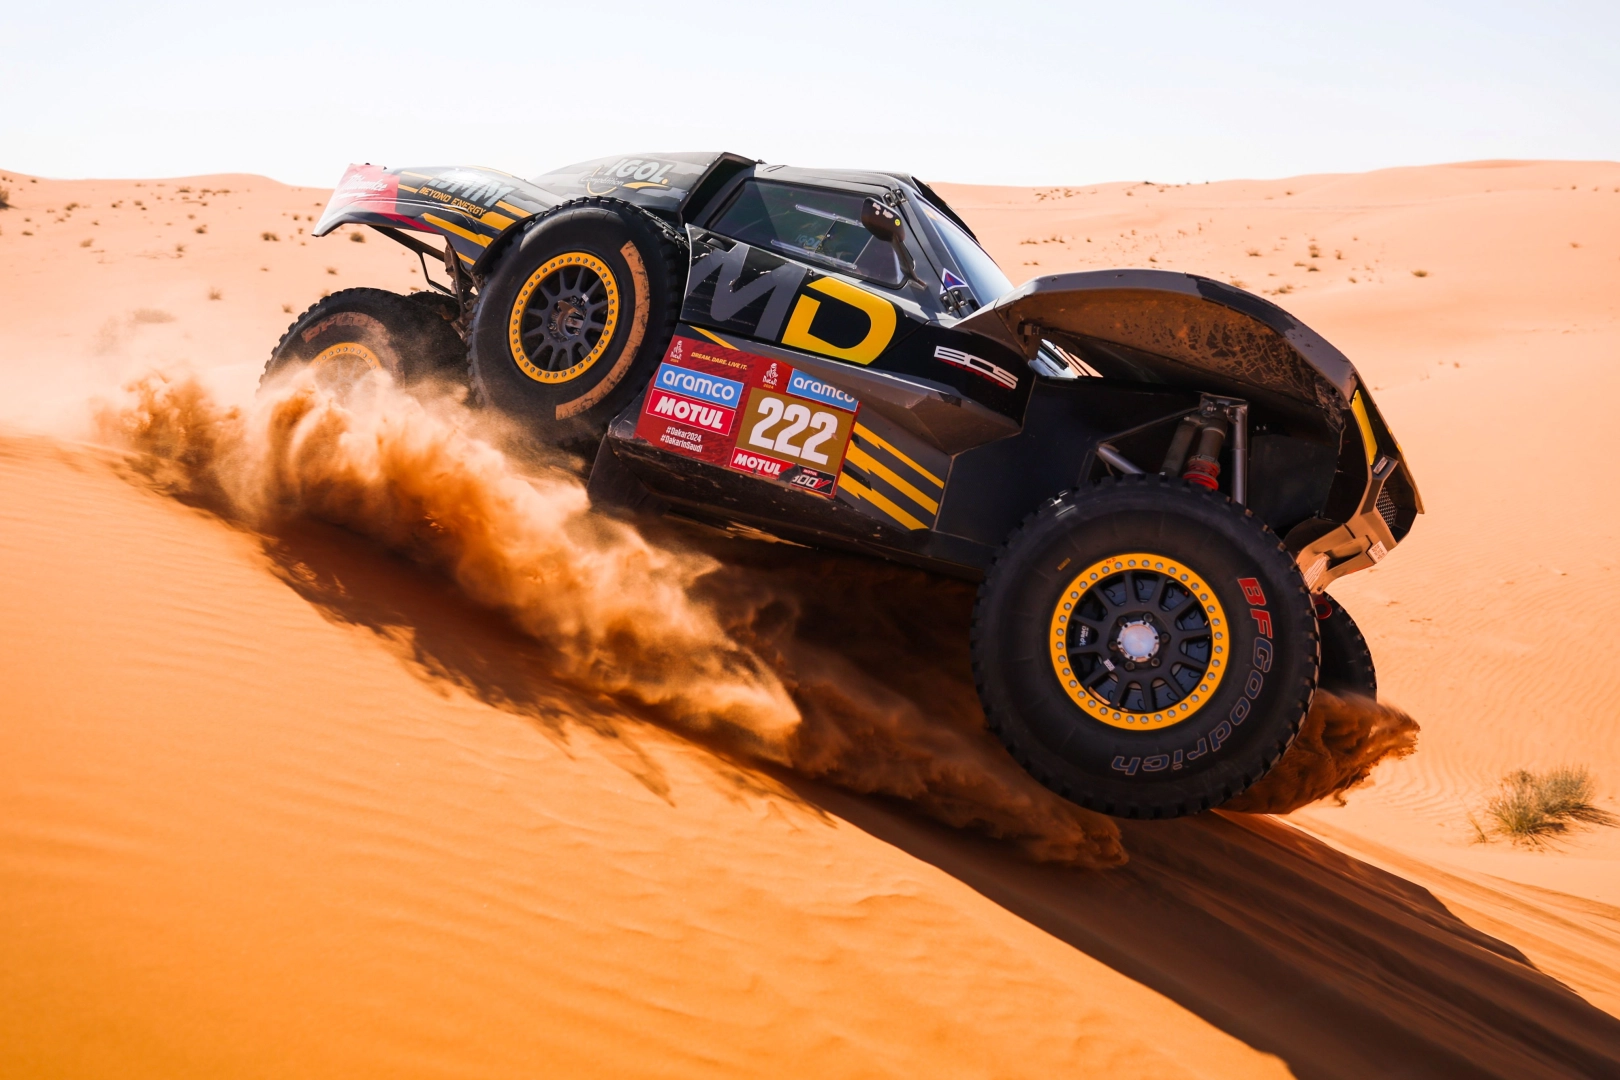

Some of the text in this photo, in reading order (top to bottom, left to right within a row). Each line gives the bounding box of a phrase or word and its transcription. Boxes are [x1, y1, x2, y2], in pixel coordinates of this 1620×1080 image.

[419, 186, 487, 217] BEYOND ENERGY
[691, 352, 711, 361] DREAM.
[711, 356, 728, 365] DARE.
[728, 360, 741, 368] LIVE
[663, 370, 735, 400] aramco
[654, 396, 723, 430] MOTUL
[666, 426, 702, 443] #Dakar2024
[749, 397, 838, 465] 222
[733, 453, 781, 475] MOTUL
[1112, 577, 1273, 776] BFGoodrich
